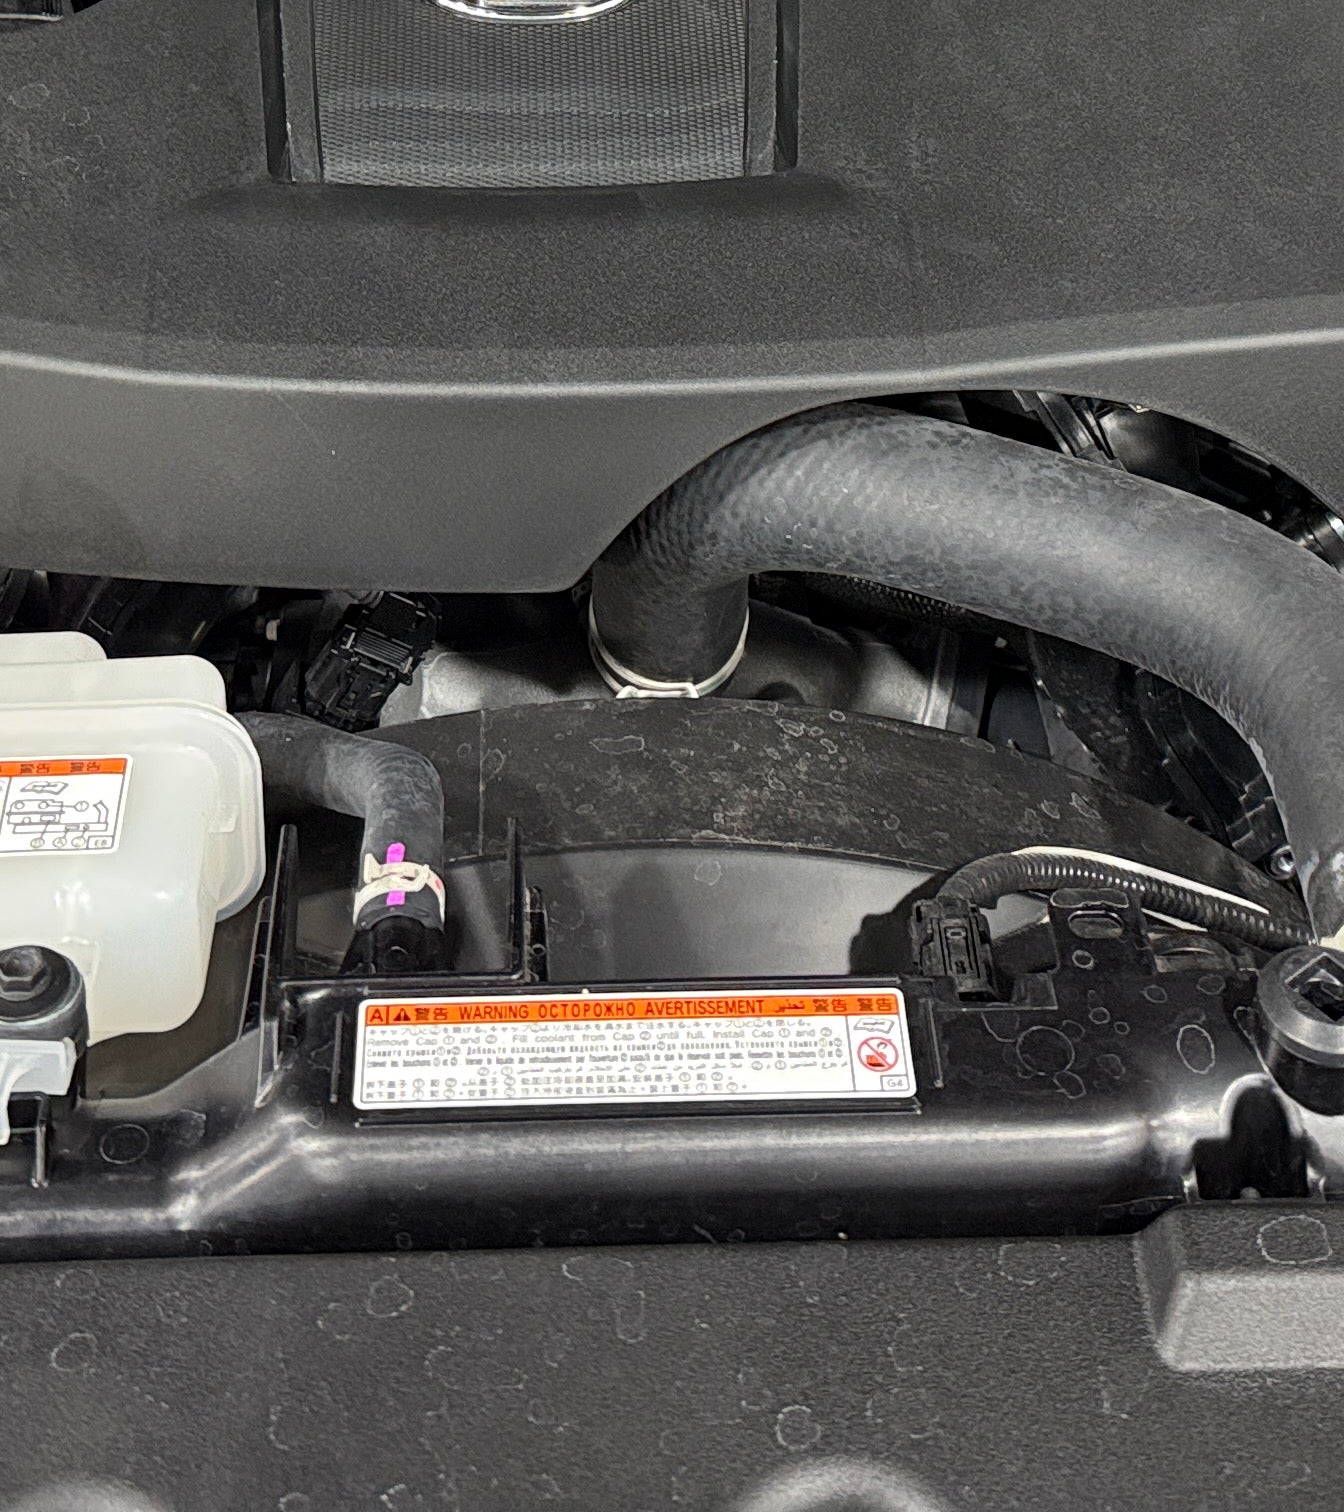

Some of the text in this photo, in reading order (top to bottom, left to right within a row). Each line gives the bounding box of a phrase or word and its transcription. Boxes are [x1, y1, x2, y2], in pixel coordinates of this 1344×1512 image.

[369, 1008, 384, 1022] A
[458, 1004, 530, 1020] WARNING
[538, 1001, 637, 1018] ОСТОРОЖНО
[644, 999, 764, 1015] AVERTISSEMENT
[367, 1038, 409, 1046] Remove
[416, 1036, 439, 1046] Cap
[460, 1035, 481, 1045] and
[534, 1032, 575, 1043] coolant
[581, 1032, 606, 1042] from
[613, 1031, 636, 1041] Cap
[656, 1030, 680, 1040] until
[712, 1029, 746, 1039] Install
[752, 1028, 775, 1038] Cap
[795, 1028, 816, 1038] and
